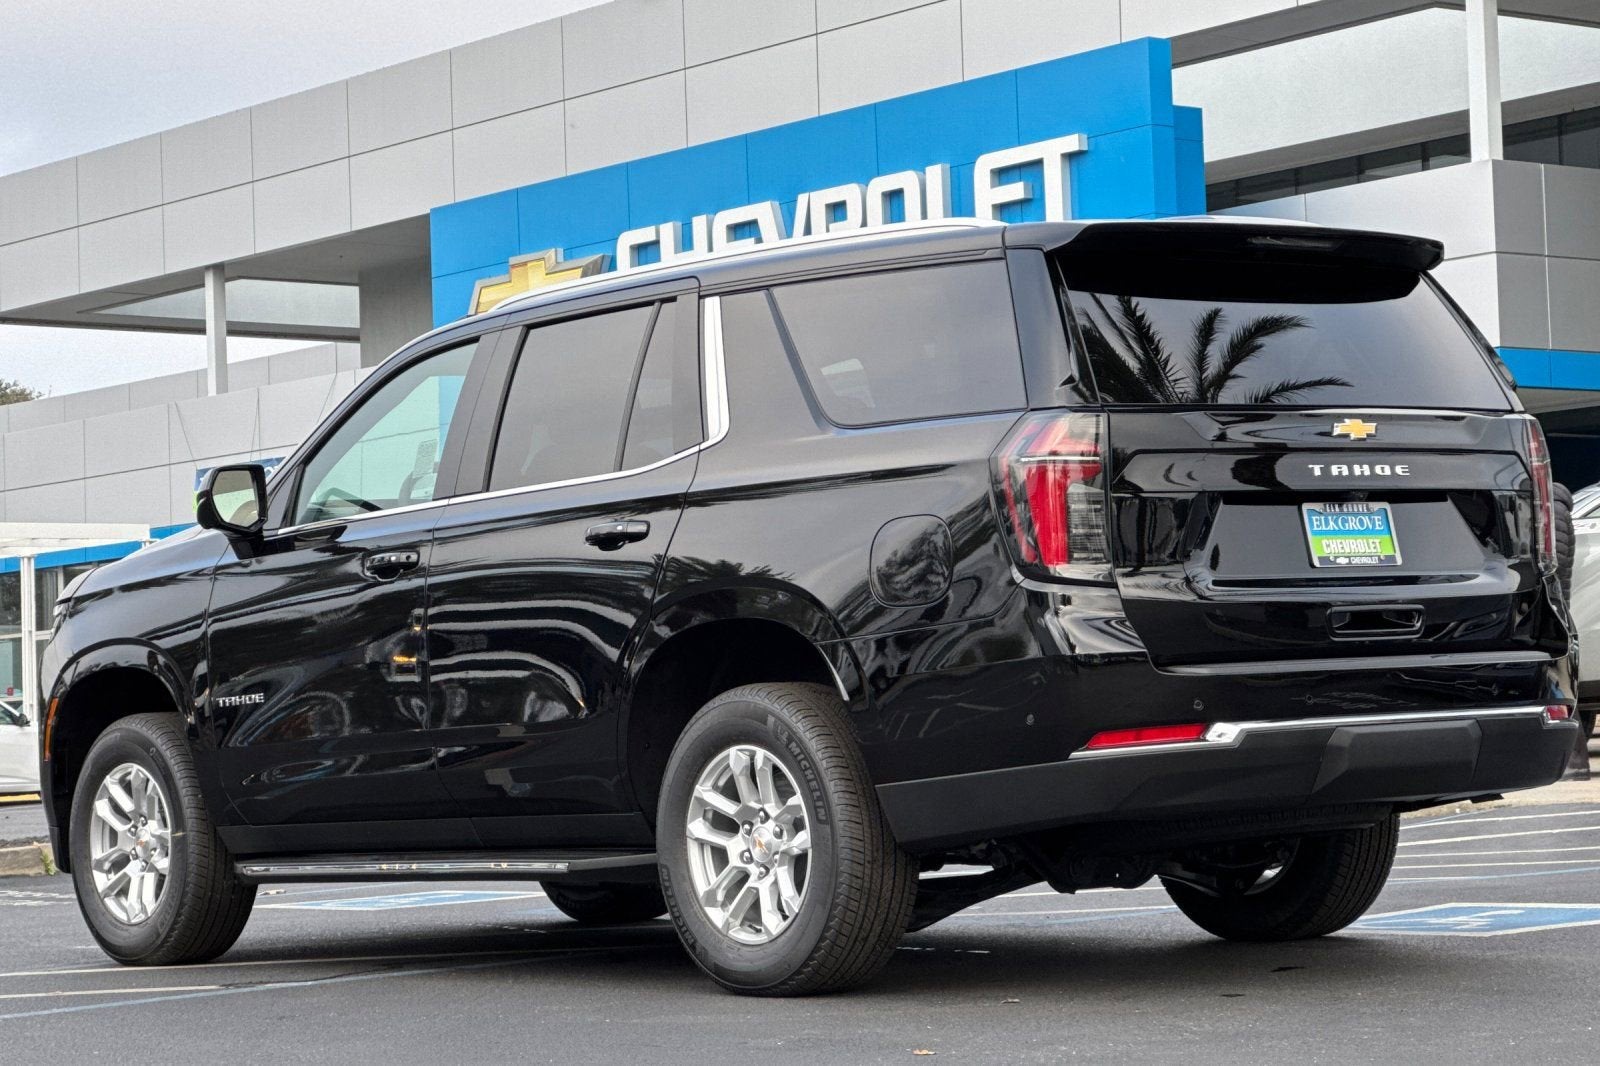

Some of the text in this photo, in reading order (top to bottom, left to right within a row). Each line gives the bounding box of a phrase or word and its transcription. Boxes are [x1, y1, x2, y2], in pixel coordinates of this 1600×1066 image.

[1308, 464, 1411, 476] TAHOE
[1321, 538, 1382, 554] CHEVROLET
[1350, 556, 1379, 564] CHEVROLET
[215, 692, 265, 707] TAHOE
[788, 741, 828, 821] MICHELIN
